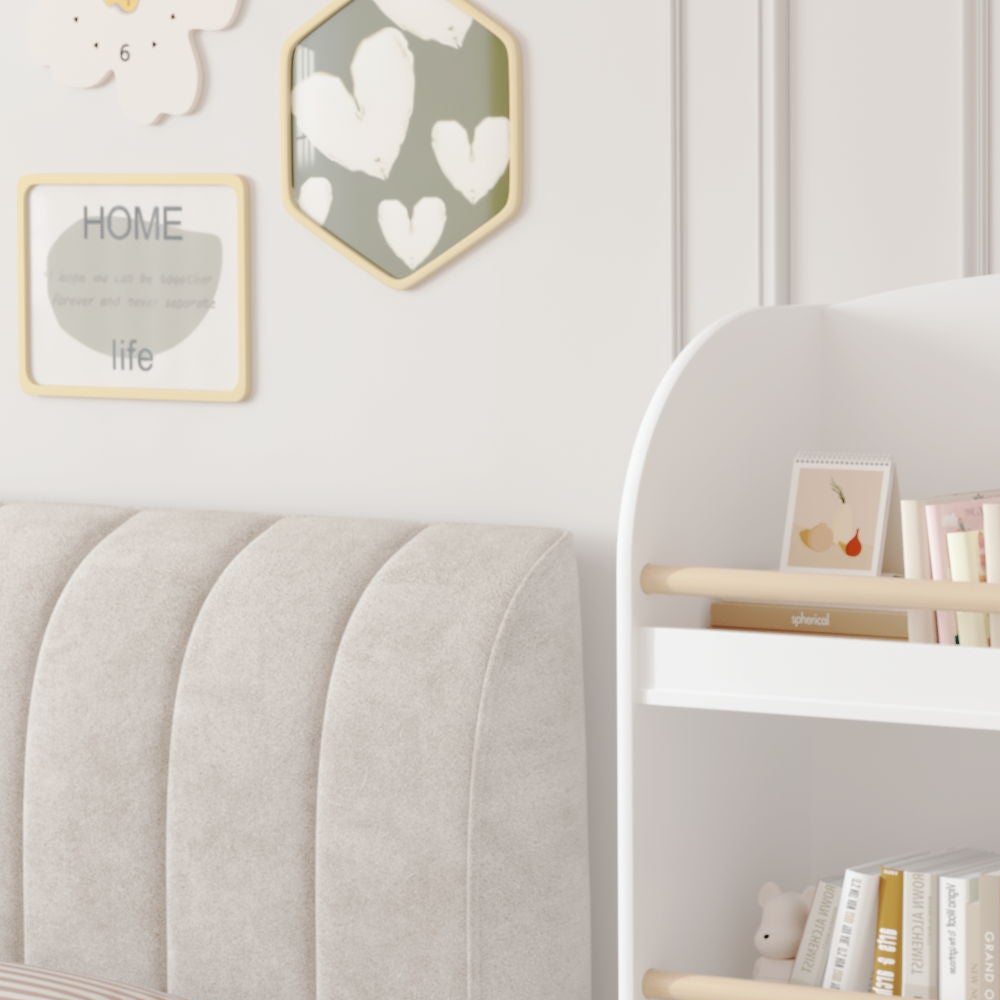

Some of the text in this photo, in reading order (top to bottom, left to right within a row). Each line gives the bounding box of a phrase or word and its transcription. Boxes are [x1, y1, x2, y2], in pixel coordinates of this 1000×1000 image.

[119, 44, 131, 62] 6
[83, 205, 183, 241] HOME
[52, 292, 95, 307] forever
[111, 339, 154, 372] life
[791, 611, 830, 628] spherical
[984, 931, 995, 983] GRAND
